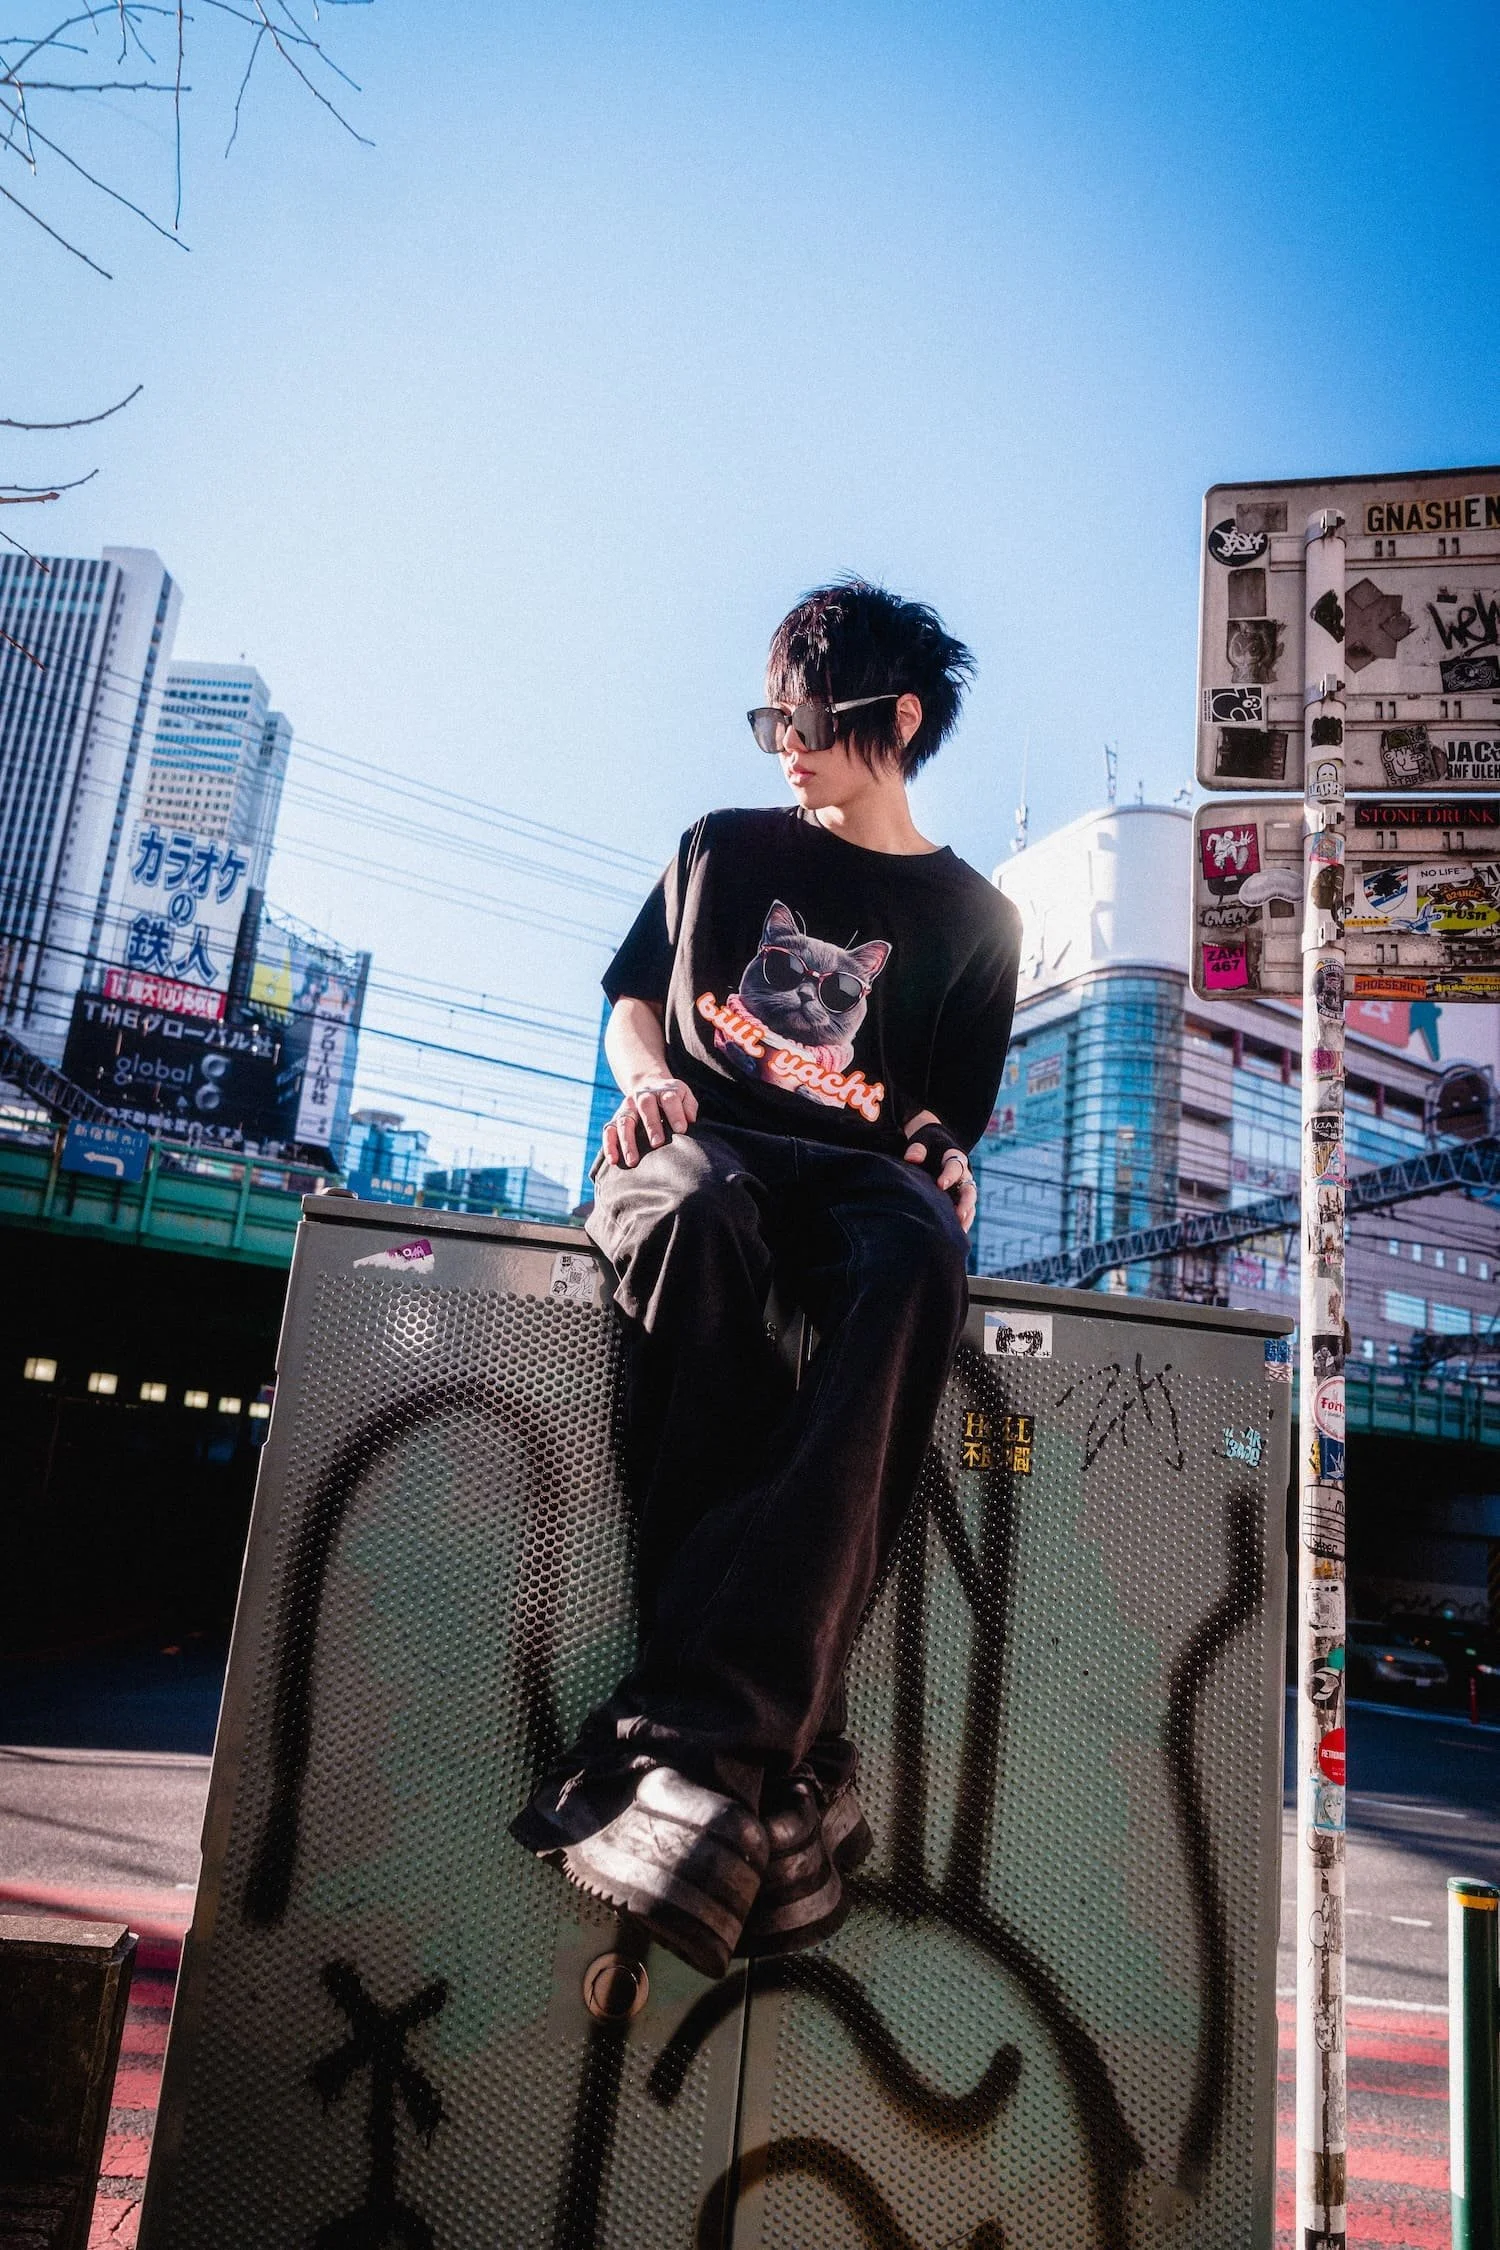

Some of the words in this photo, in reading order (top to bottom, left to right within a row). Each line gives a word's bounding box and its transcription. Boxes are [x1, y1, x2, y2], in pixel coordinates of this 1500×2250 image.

[1424, 807, 1495, 824] DRUNK
[132, 826, 249, 904] カラオケ
[1420, 868, 1437, 878] NO
[169, 889, 196, 928] の
[126, 914, 219, 985] 鉄人
[1212, 959, 1241, 972] 467
[115, 1052, 194, 1086] global
[768, 1047, 885, 1122] yacht
[1320, 1396, 1345, 1414] Fort
[964, 1411, 1031, 1443] HLL
